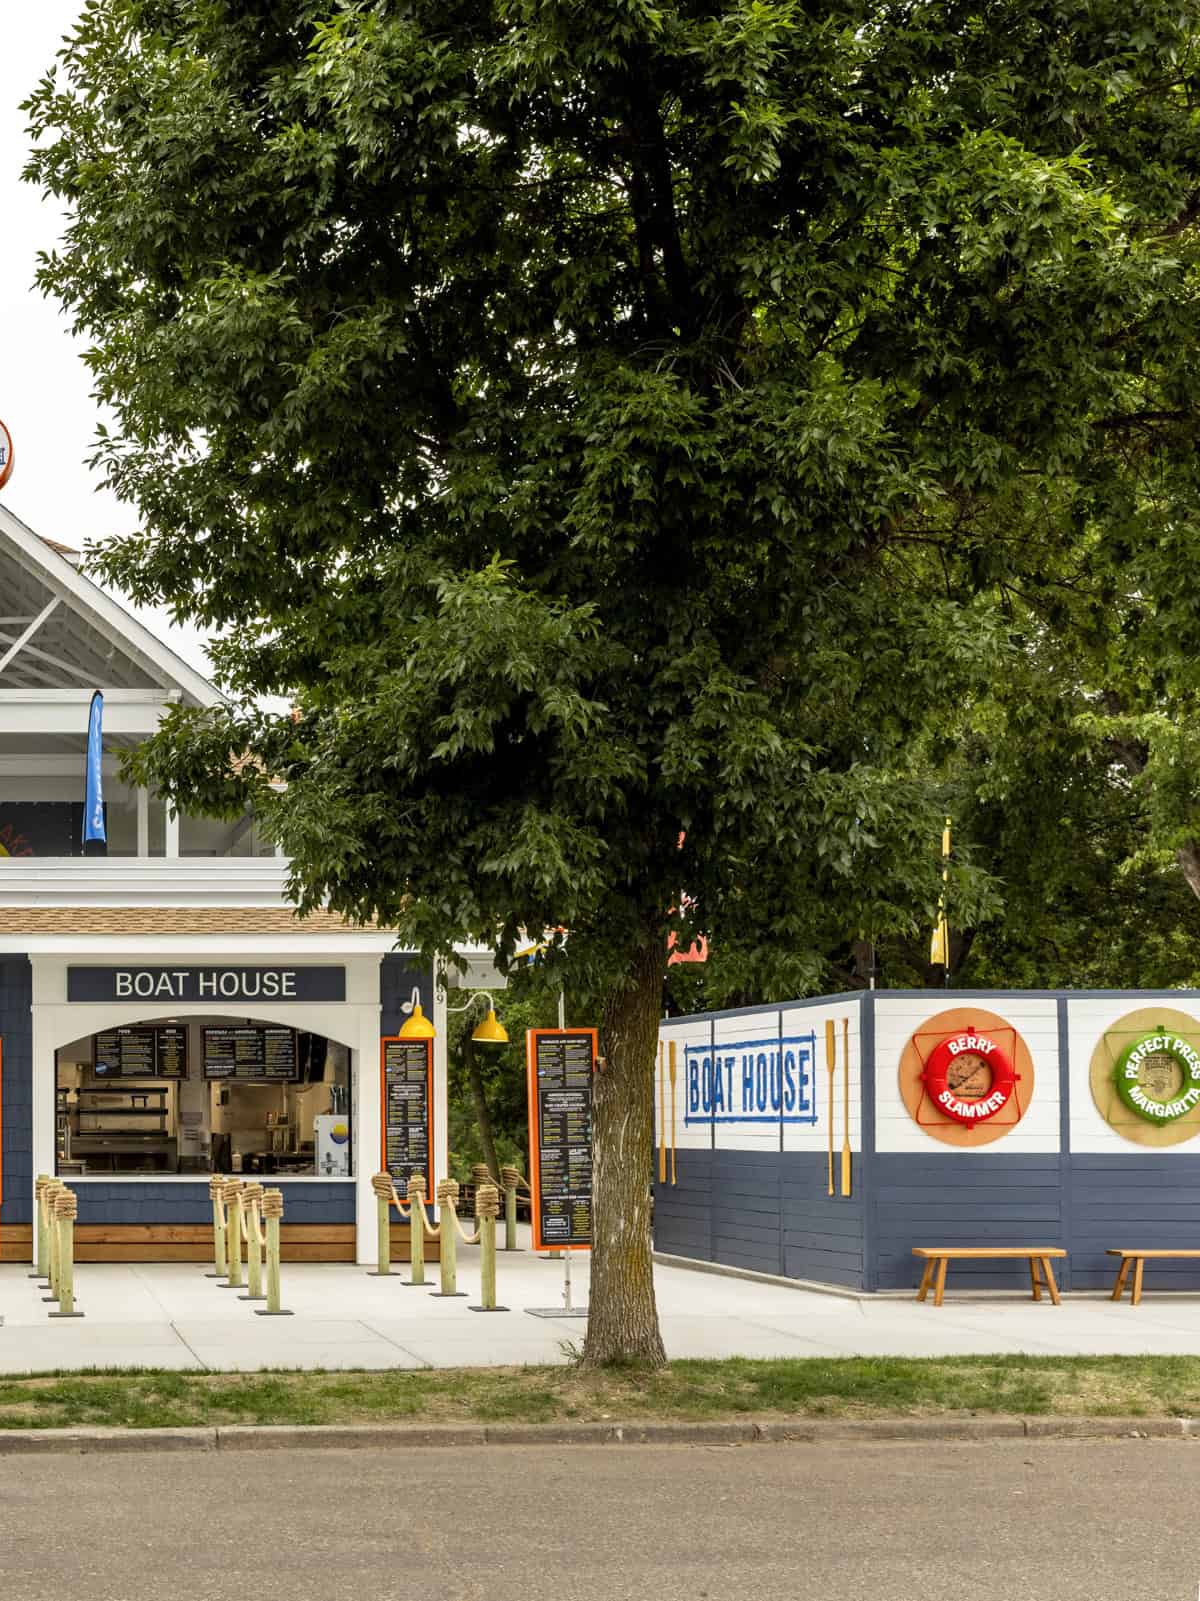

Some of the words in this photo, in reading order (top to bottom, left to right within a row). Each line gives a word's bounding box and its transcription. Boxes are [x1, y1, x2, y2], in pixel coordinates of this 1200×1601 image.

[116, 972, 189, 996] BOAT
[199, 972, 297, 996] HOUSE
[948, 1036, 998, 1056] BERRY
[1125, 1036, 1172, 1079] PERFECT
[1172, 1039, 1200, 1080] PRESS
[689, 1056, 736, 1113] BOAT
[742, 1049, 810, 1112] HOUSE
[938, 1090, 1007, 1118] SLAMMER
[1128, 1085, 1200, 1118] MARGARITA
